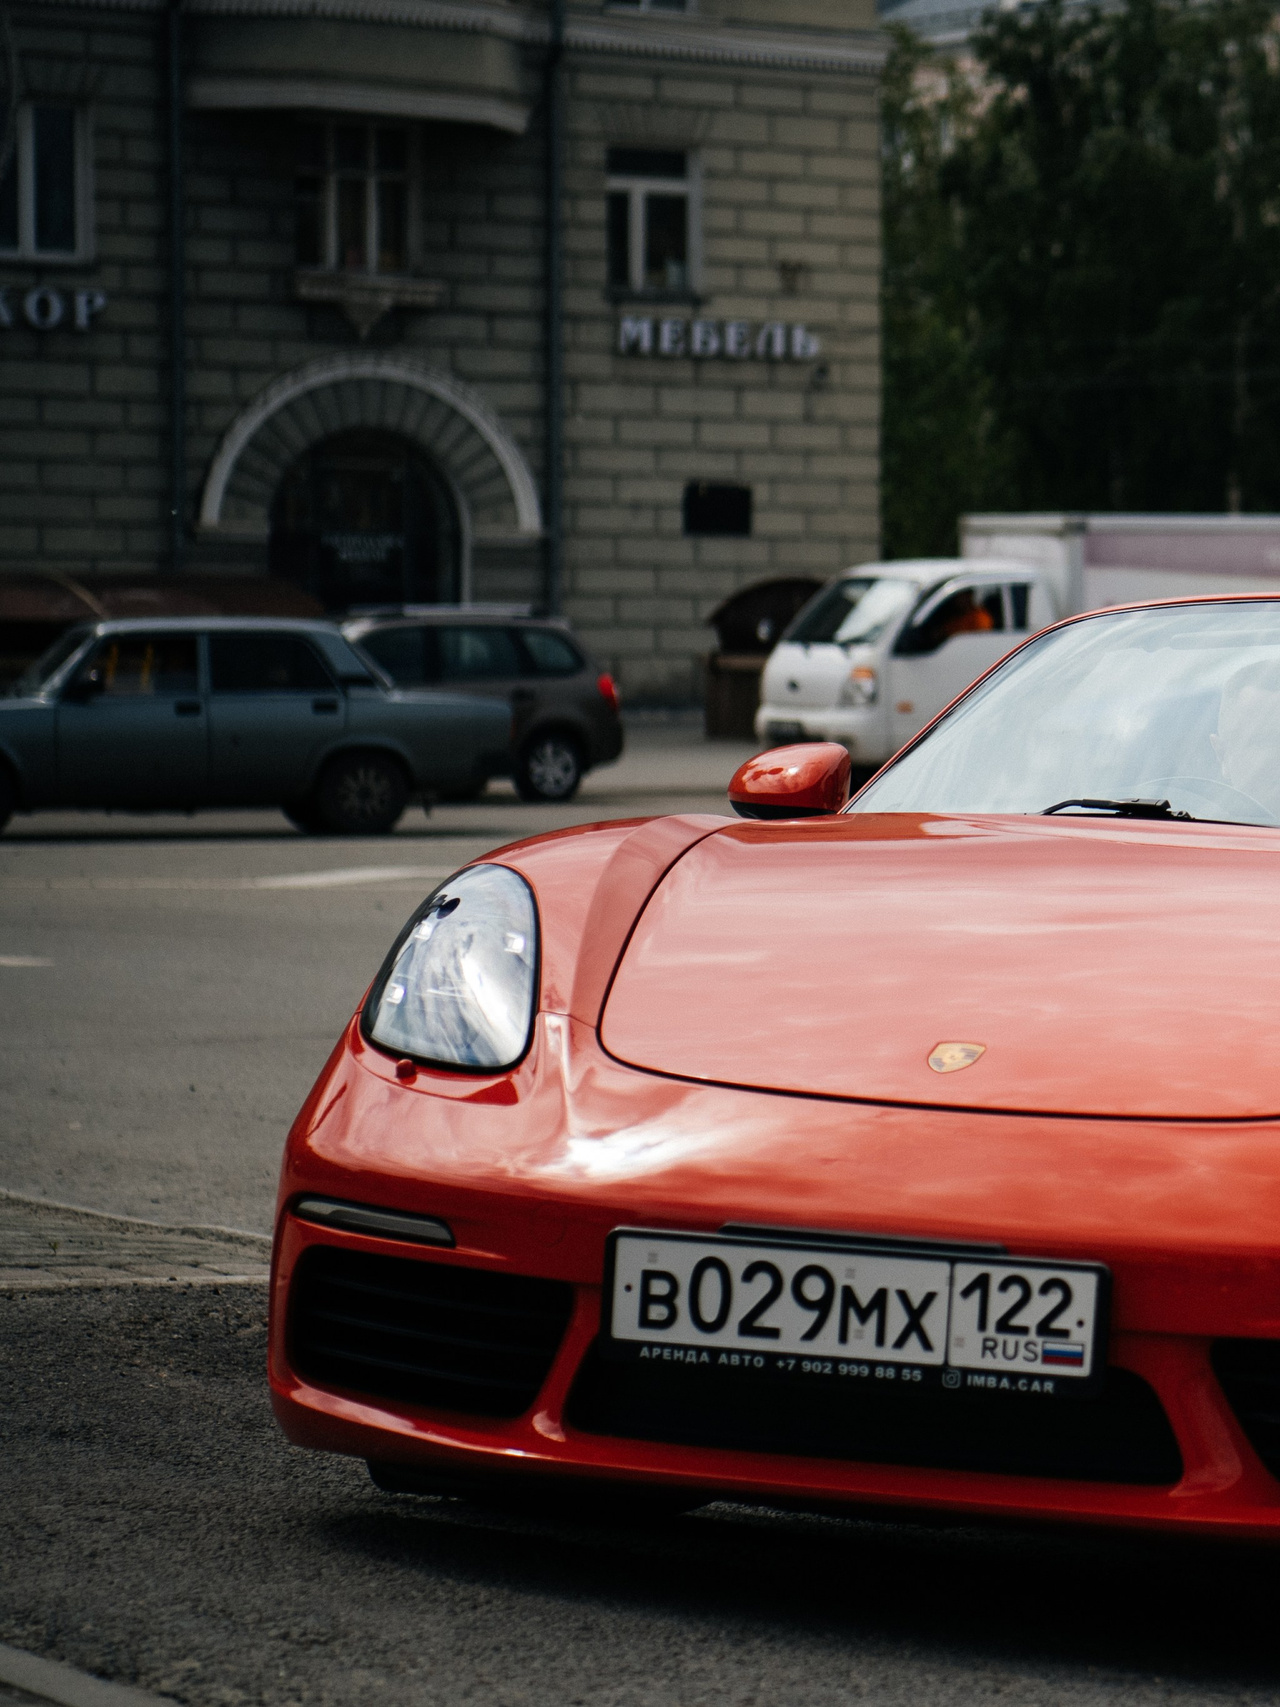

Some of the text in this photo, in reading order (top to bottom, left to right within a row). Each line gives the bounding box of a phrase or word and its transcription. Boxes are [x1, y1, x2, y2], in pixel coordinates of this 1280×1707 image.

[620, 316, 822, 358] МЕБЕЛЬ
[637, 1256, 1074, 1352] В029МХ 122
[639, 1346, 923, 1382] АРЕНДА АВТО +7 902 999 88 55
[980, 1337, 1039, 1362] RUS
[967, 1373, 1055, 1394] IMBA.CAR
